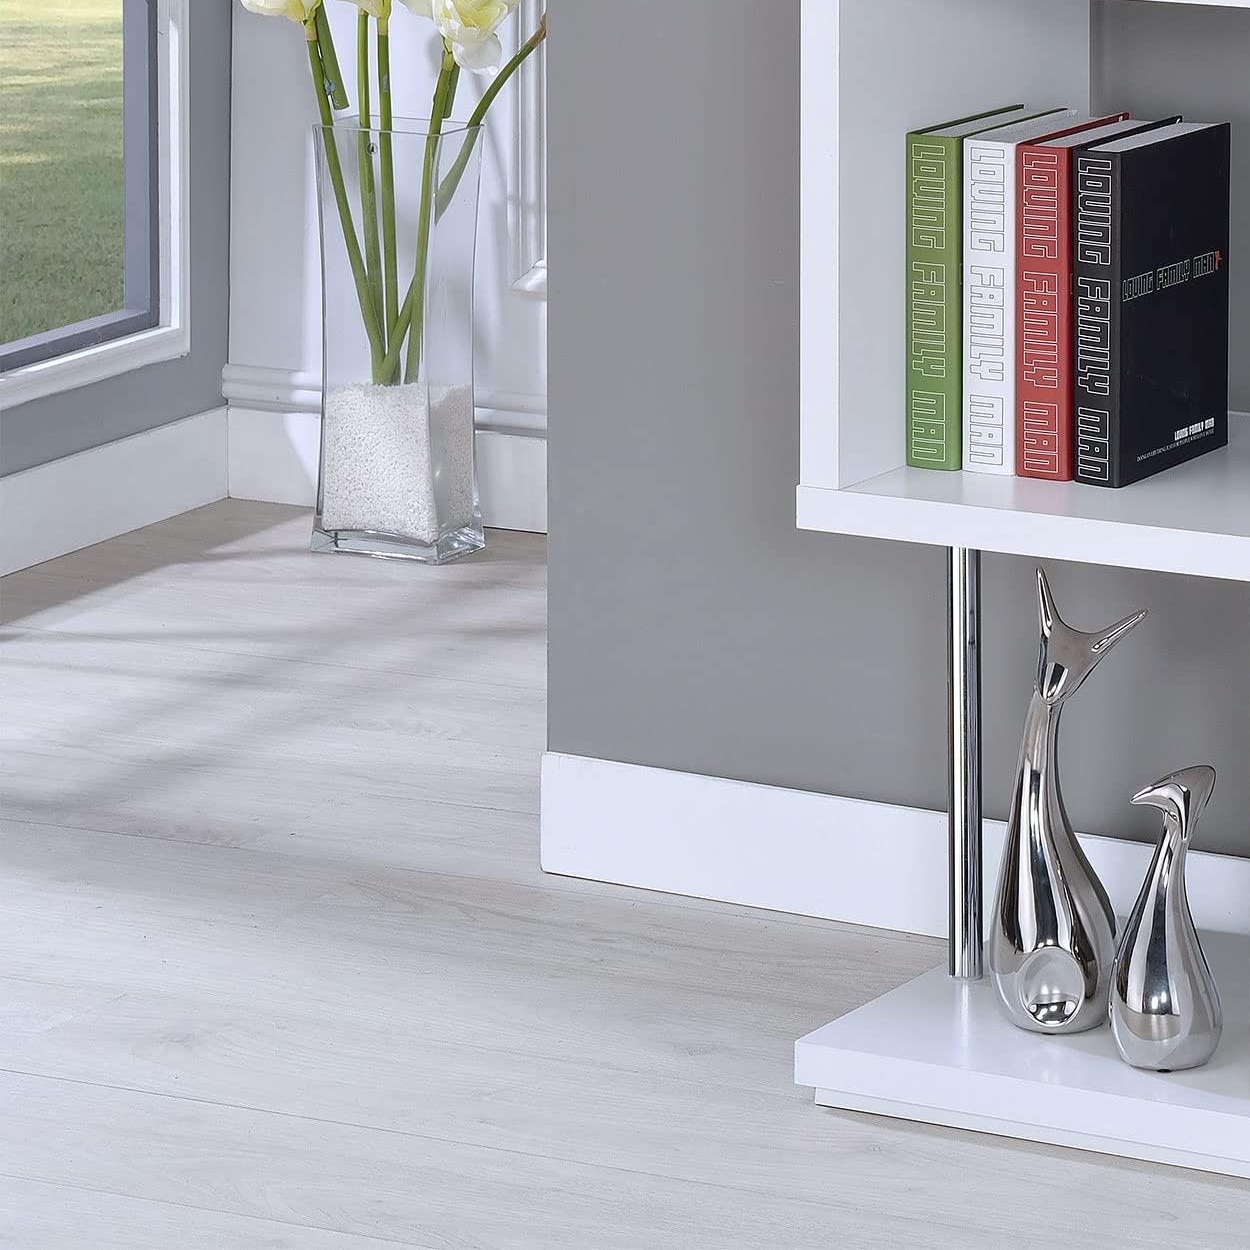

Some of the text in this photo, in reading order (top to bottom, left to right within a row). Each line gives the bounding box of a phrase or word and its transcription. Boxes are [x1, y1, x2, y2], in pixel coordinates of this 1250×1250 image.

[1156, 259, 1190, 291] FAMILY
[912, 261, 945, 378] FAMILY
[970, 265, 1004, 381] FAMILY
[1023, 271, 1057, 388] FAMILY
[1078, 276, 1110, 395] FAMILY
[912, 390, 945, 462] MAN
[970, 394, 1003, 466] MAN
[1024, 401, 1058, 473] MAN
[1078, 406, 1109, 480] MAN
